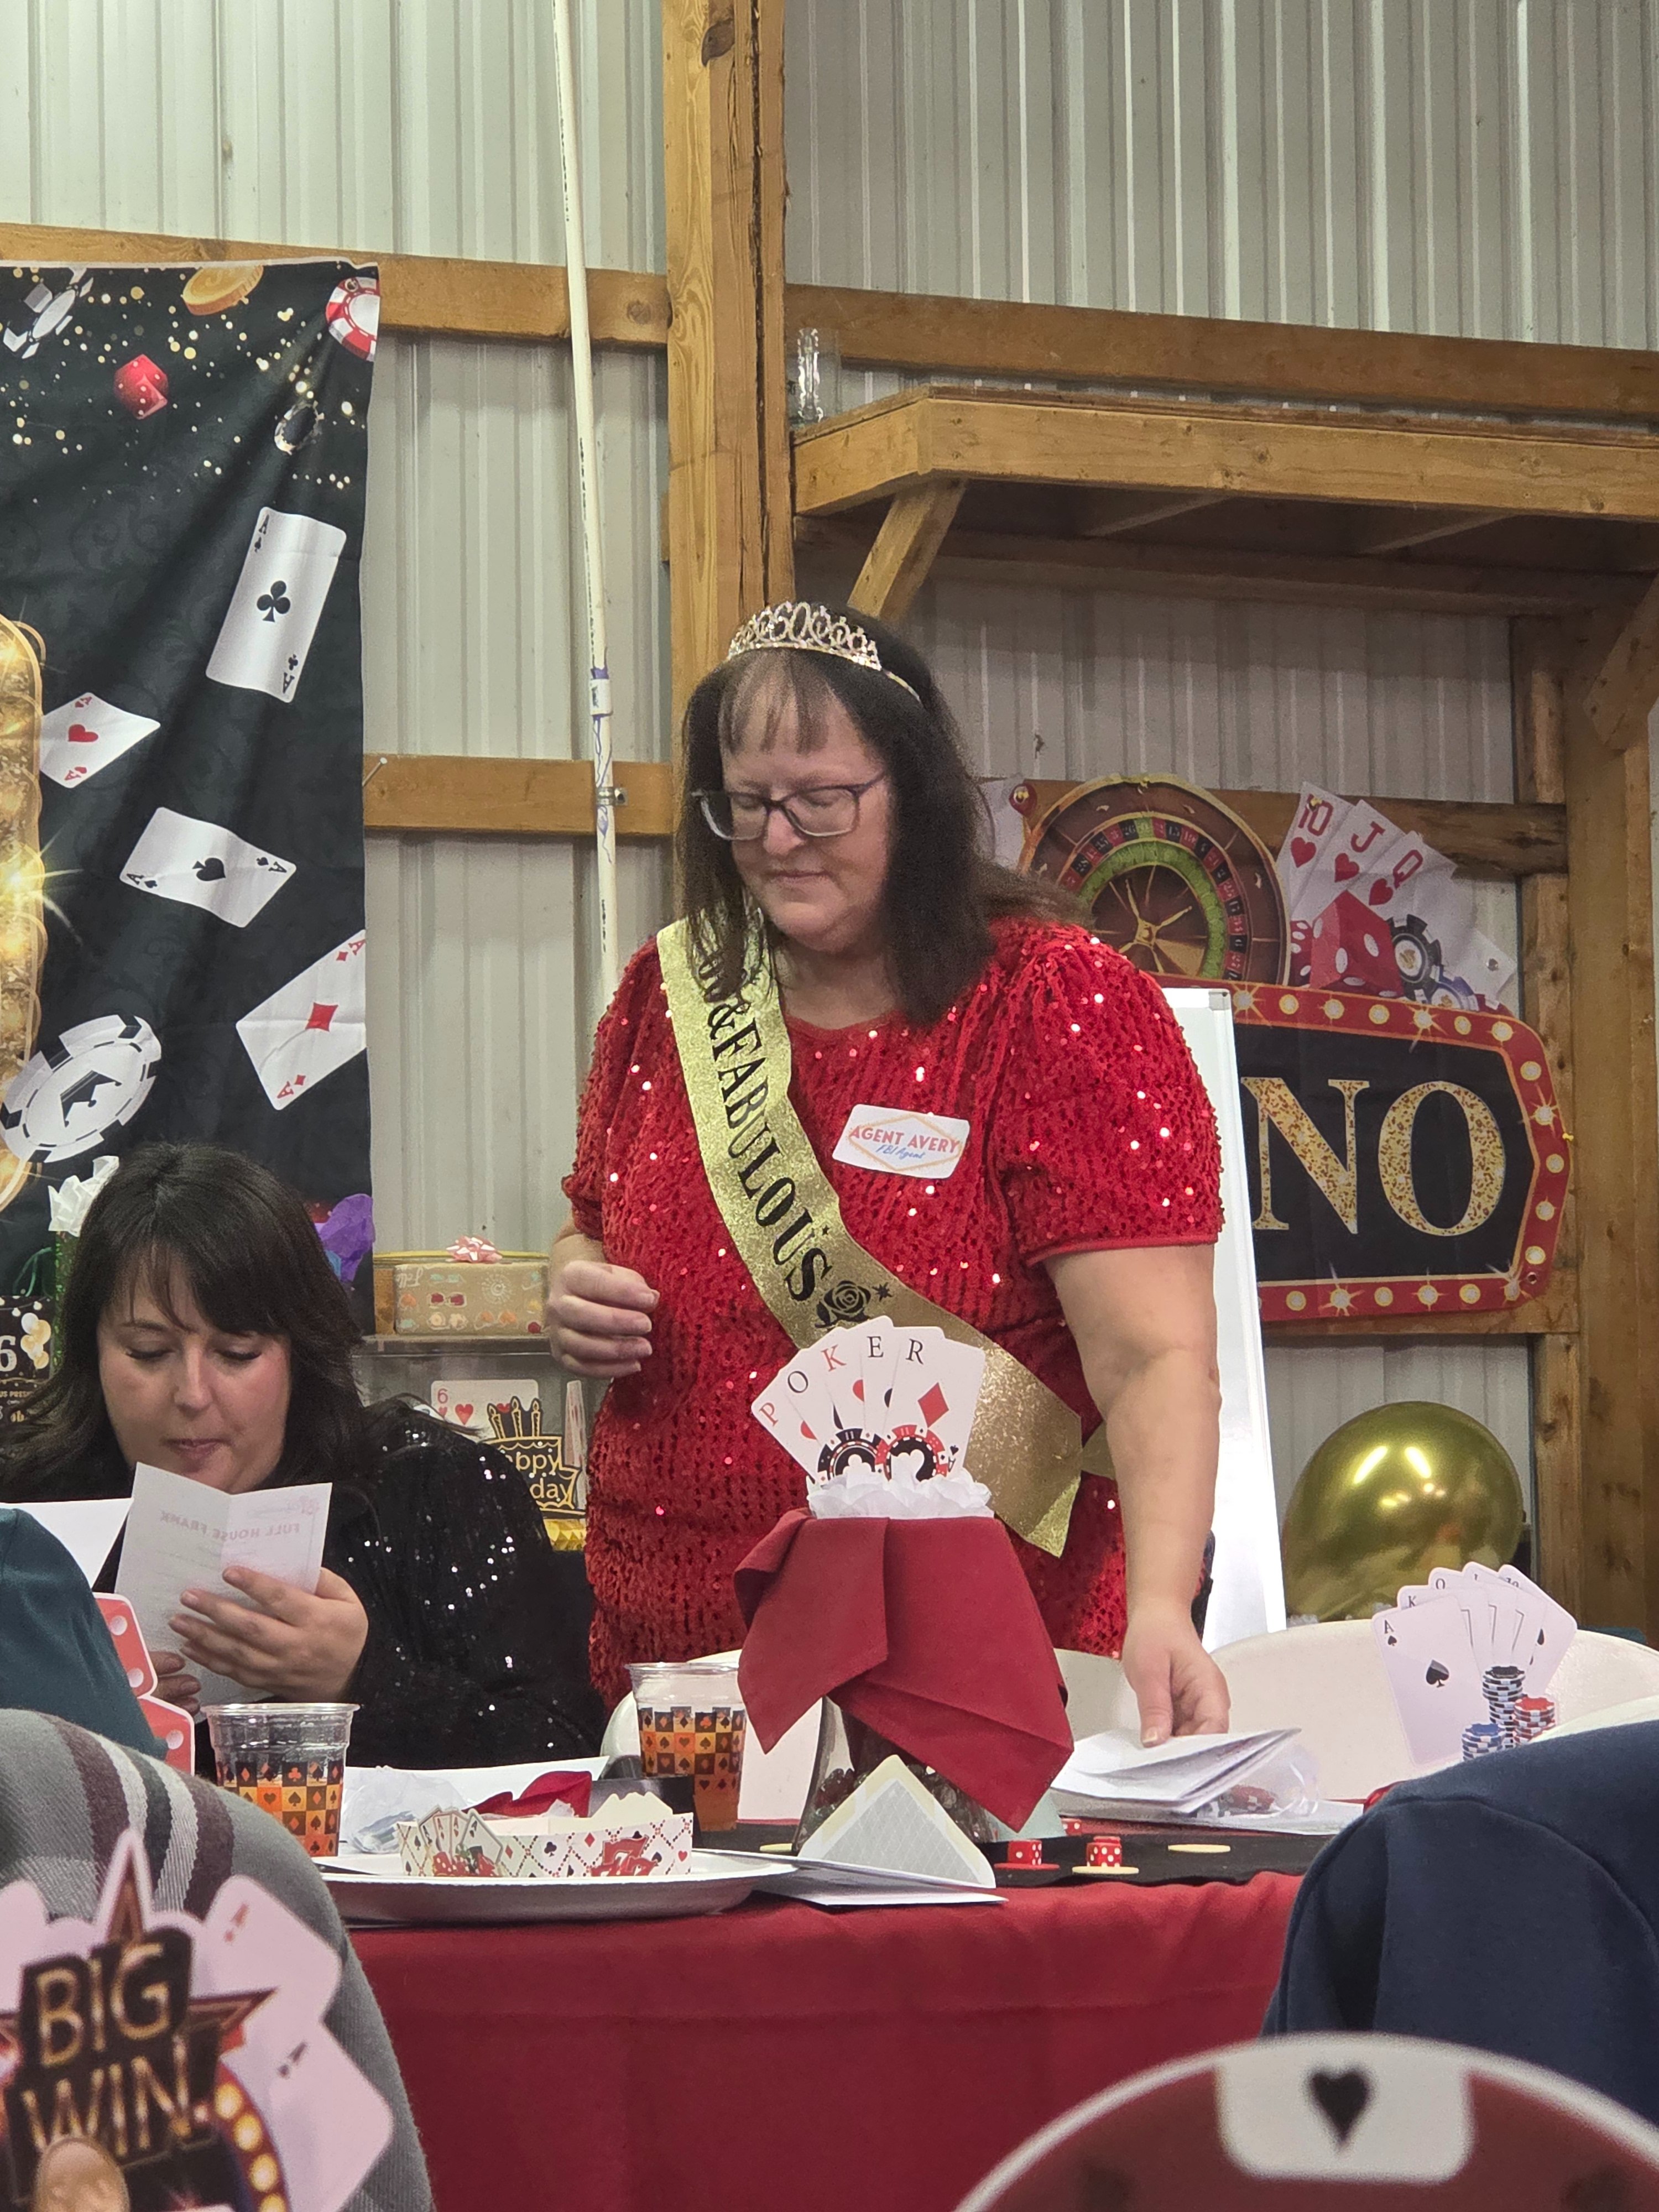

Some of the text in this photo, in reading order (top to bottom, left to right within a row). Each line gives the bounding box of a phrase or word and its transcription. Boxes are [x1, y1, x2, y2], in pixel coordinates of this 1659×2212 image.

[258, 514, 269, 534] A
[283, 672, 295, 693] A
[1351, 821, 1386, 853] J
[1392, 849, 1423, 889] Q
[268, 862, 287, 873] A
[127, 873, 144, 885] A
[348, 939, 366, 956] A
[276, 1081, 294, 1099] A
[848, 1126, 961, 1154] AGENT AVERY
[897, 1147, 926, 1160] Agent
[437, 1388, 448, 1404] 6
[505, 1451, 559, 1476] ppy
[1384, 1620, 1394, 1634] A
[36, 1943, 169, 2067] BIG
